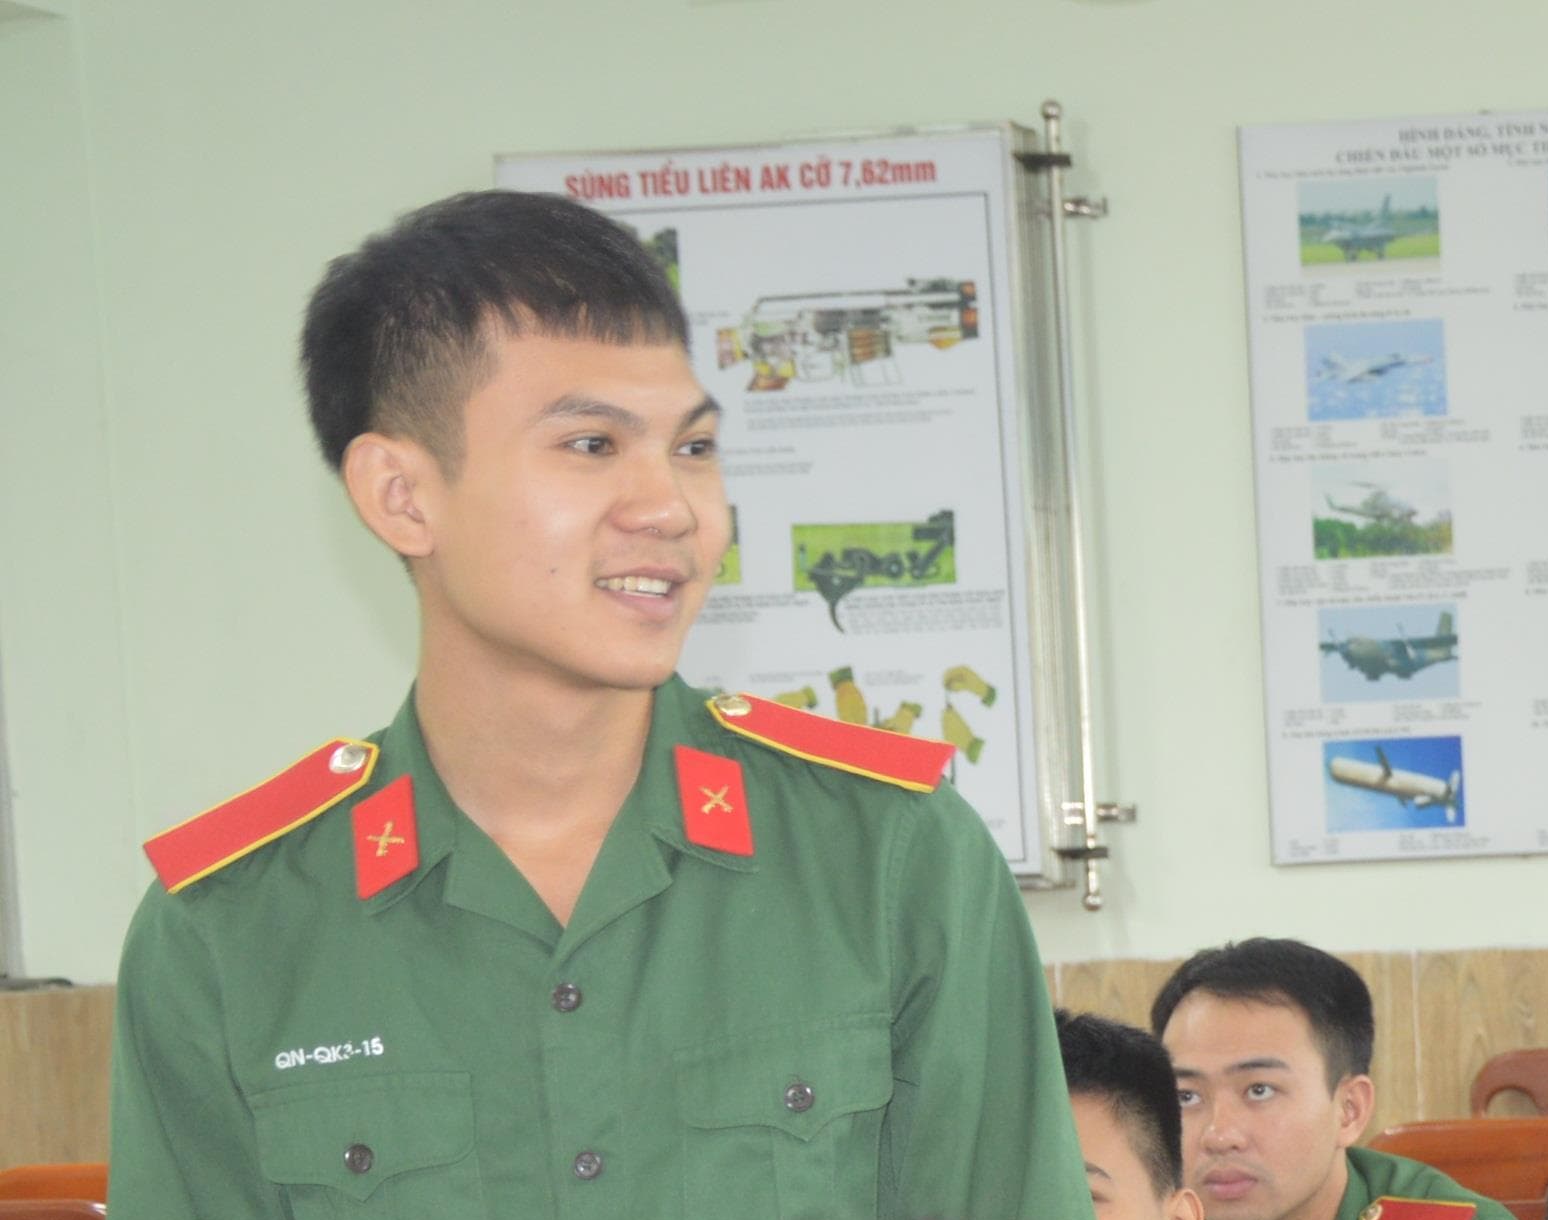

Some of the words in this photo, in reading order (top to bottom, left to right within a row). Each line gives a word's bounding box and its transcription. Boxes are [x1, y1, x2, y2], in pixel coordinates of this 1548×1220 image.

[699, 162, 750, 194] LIÊN
[760, 164, 791, 190] AK
[840, 159, 937, 188] 7,62mm
